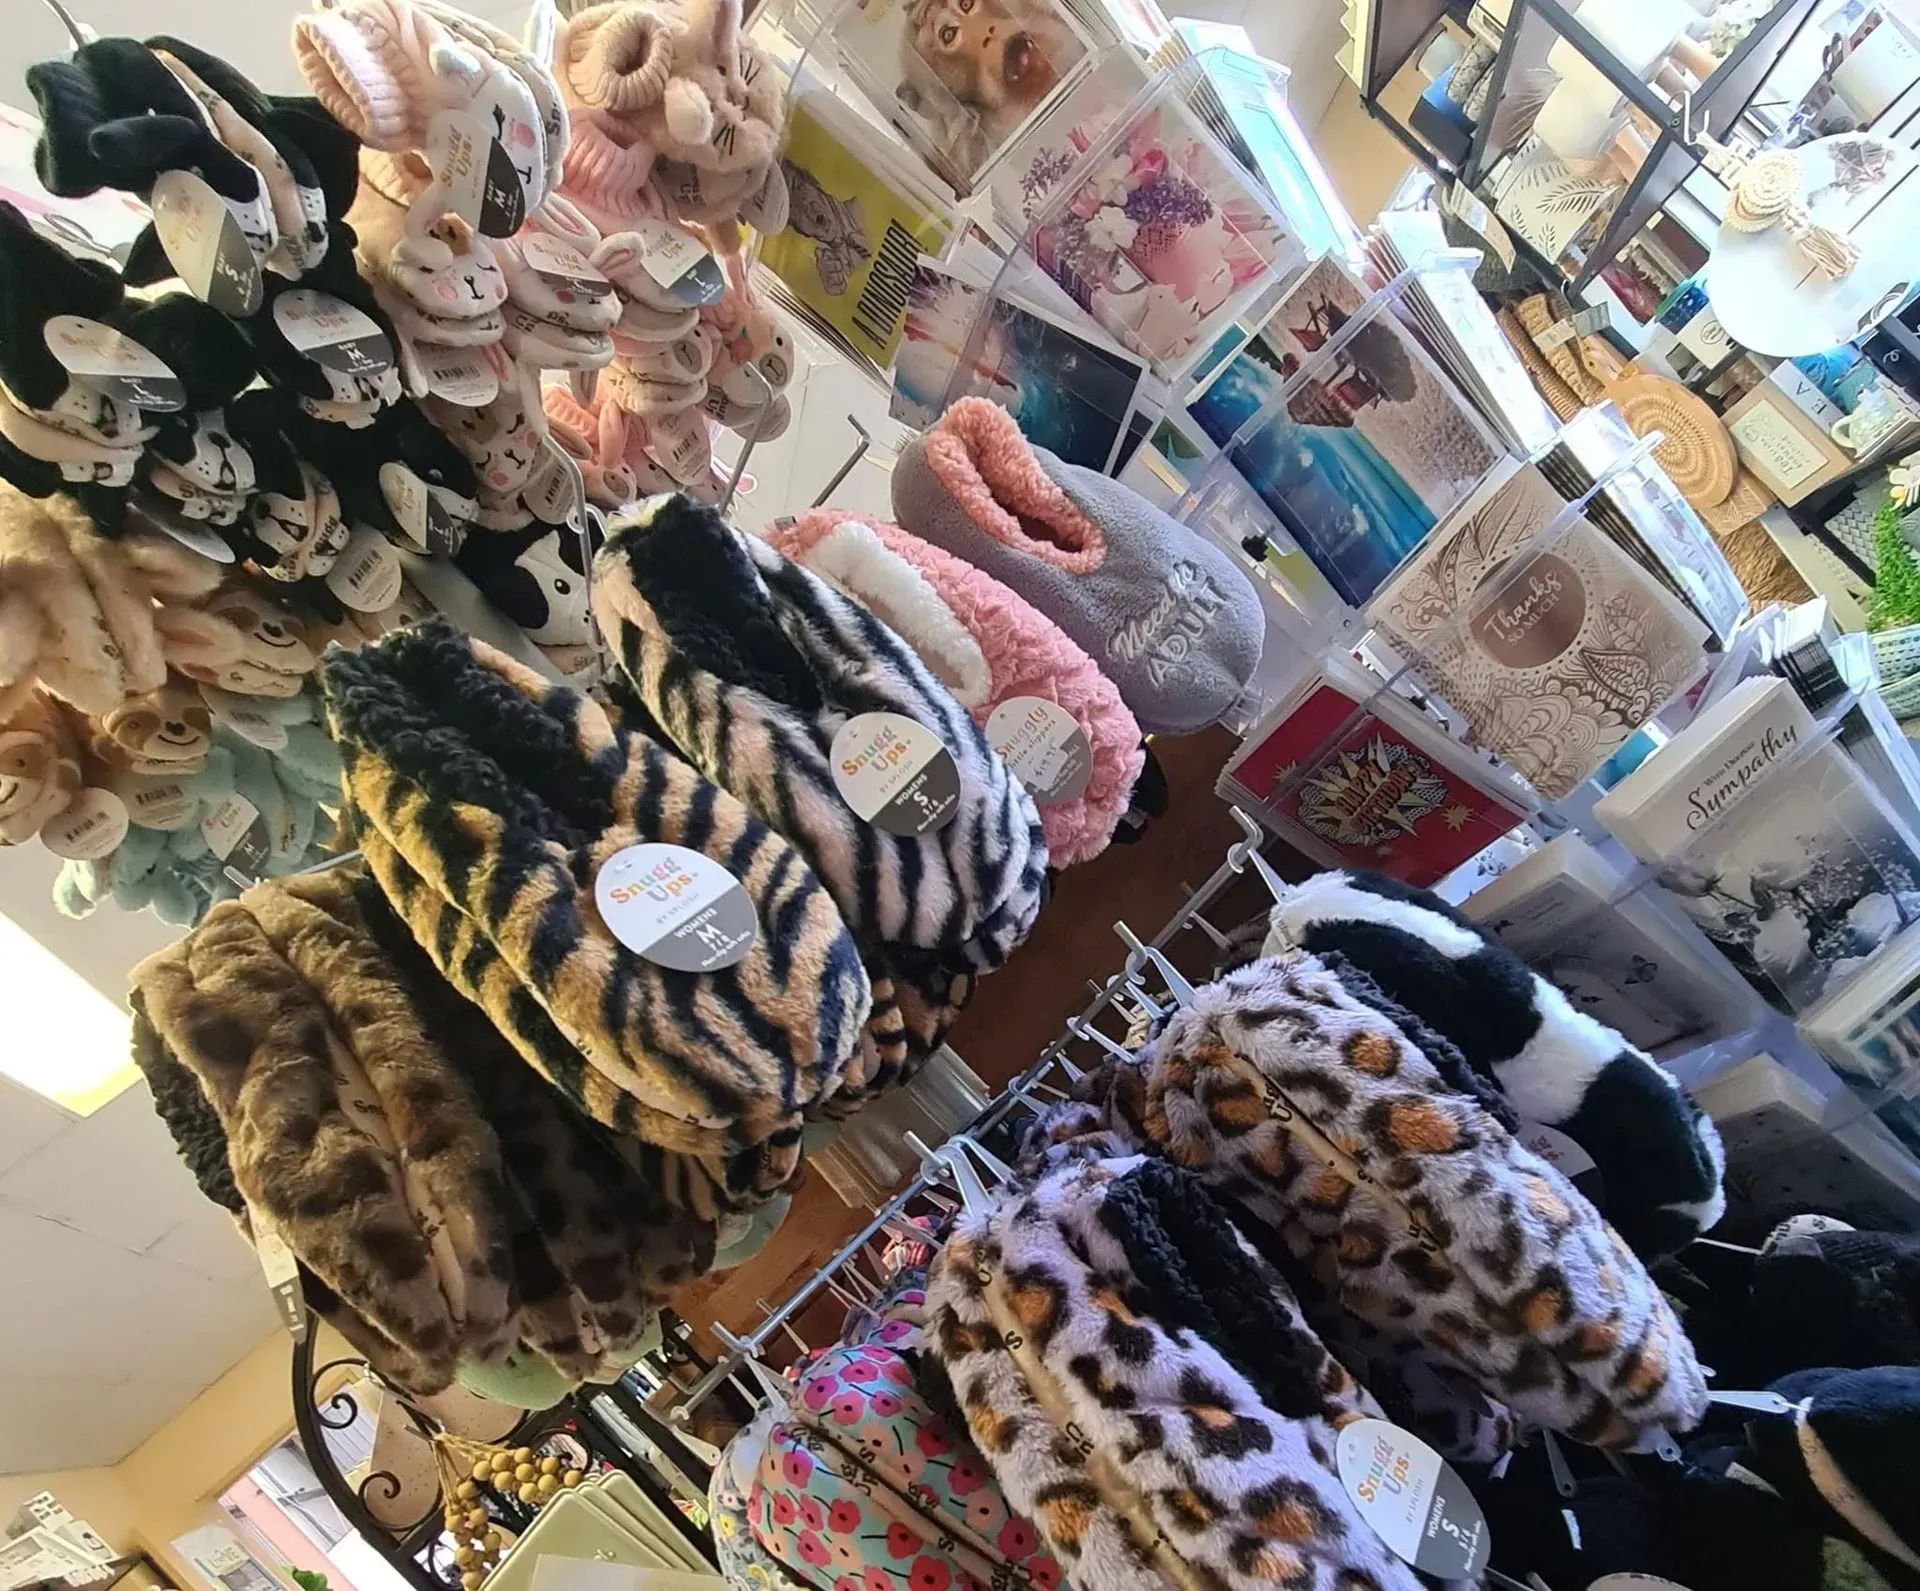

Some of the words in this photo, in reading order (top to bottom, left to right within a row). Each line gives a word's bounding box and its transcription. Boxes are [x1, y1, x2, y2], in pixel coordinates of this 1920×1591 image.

[493, 188, 507, 209] M
[856, 218, 929, 336] DINOSAUR!
[345, 347, 365, 361] M
[851, 316, 888, 351] A
[1483, 569, 1563, 640] Thanks
[1507, 627, 1525, 646] SO
[1522, 591, 1561, 629] MUCH
[1146, 581, 1234, 688] ADULT
[841, 725, 897, 776] Snugg
[993, 706, 1049, 760] Snuggly
[894, 773, 928, 806] WOMENS
[913, 790, 929, 807] S
[1334, 758, 1387, 817] HAPPY
[1686, 724, 1798, 831] Sympathy
[609, 856, 682, 904] Snugg
[673, 907, 719, 939] WOMENS
[695, 923, 722, 945] M
[1357, 1435, 1395, 1503] Snugg
[1427, 1494, 1446, 1539] WOMENS
[1441, 1518, 1460, 1539] S
